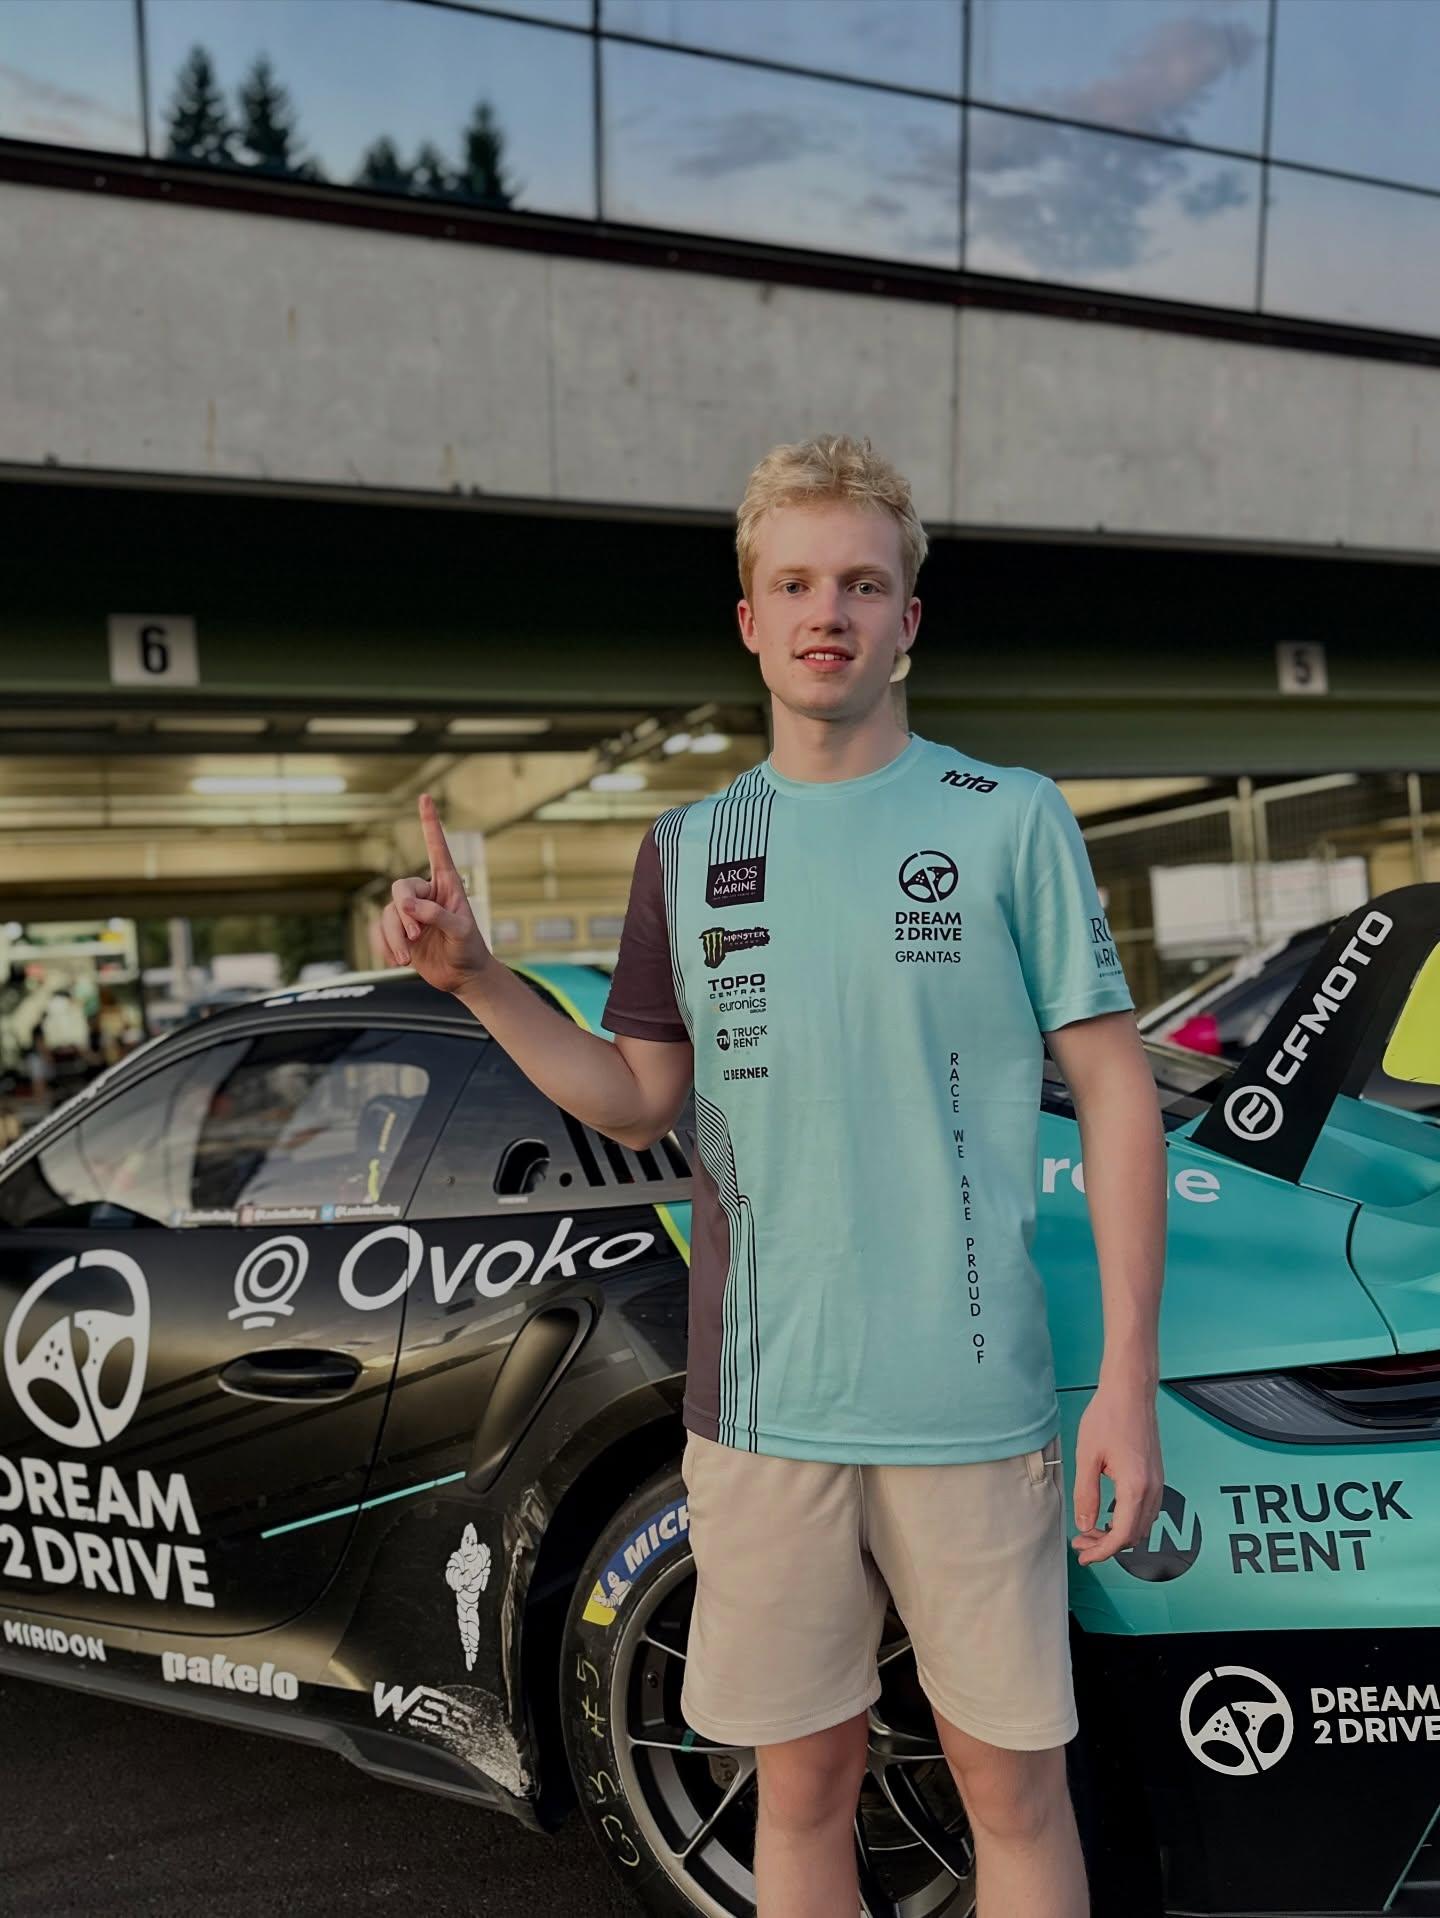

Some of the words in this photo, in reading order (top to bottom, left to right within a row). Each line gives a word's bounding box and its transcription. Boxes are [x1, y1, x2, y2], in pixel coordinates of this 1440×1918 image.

[140, 624, 170, 675] 6
[1292, 649, 1312, 685] 5
[713, 880, 757, 896] MARINE
[714, 865, 758, 885] AROS
[895, 912, 962, 925] DREAM
[723, 931, 766, 942] MONSTER
[895, 929, 905, 940] 2
[908, 928, 962, 941] DRIVE
[895, 951, 961, 963] GRANTAS
[708, 973, 766, 991] TOPO
[709, 987, 766, 1000] CENTRAS
[719, 996, 767, 1013] euronics
[1266, 911, 1393, 1085] CFMOTO
[732, 1025, 768, 1038] TRUCK
[733, 1037, 760, 1048] RENT
[731, 1066, 769, 1080] BERNER
[949, 1052, 960, 1113] RACE
[953, 1129, 964, 1159] WE
[961, 1174, 972, 1221] ARE
[338, 1217, 655, 1311] Ovoko
[966, 1237, 981, 1317] PROUD
[972, 1333, 985, 1364] OF
[0, 1454, 201, 1535] DREAM
[1219, 1480, 1414, 1525] TRUCK
[0, 1523, 32, 1579] 2
[32, 1525, 215, 1608] DRIVE
[1228, 1529, 1372, 1574] RENT
[3, 1620, 107, 1662] MIRIDON
[161, 1651, 299, 1700] pakelo
[1310, 1684, 1440, 1714] DREAM
[1313, 1719, 1333, 1744] 2
[1338, 1715, 1440, 1744] DRIVE
